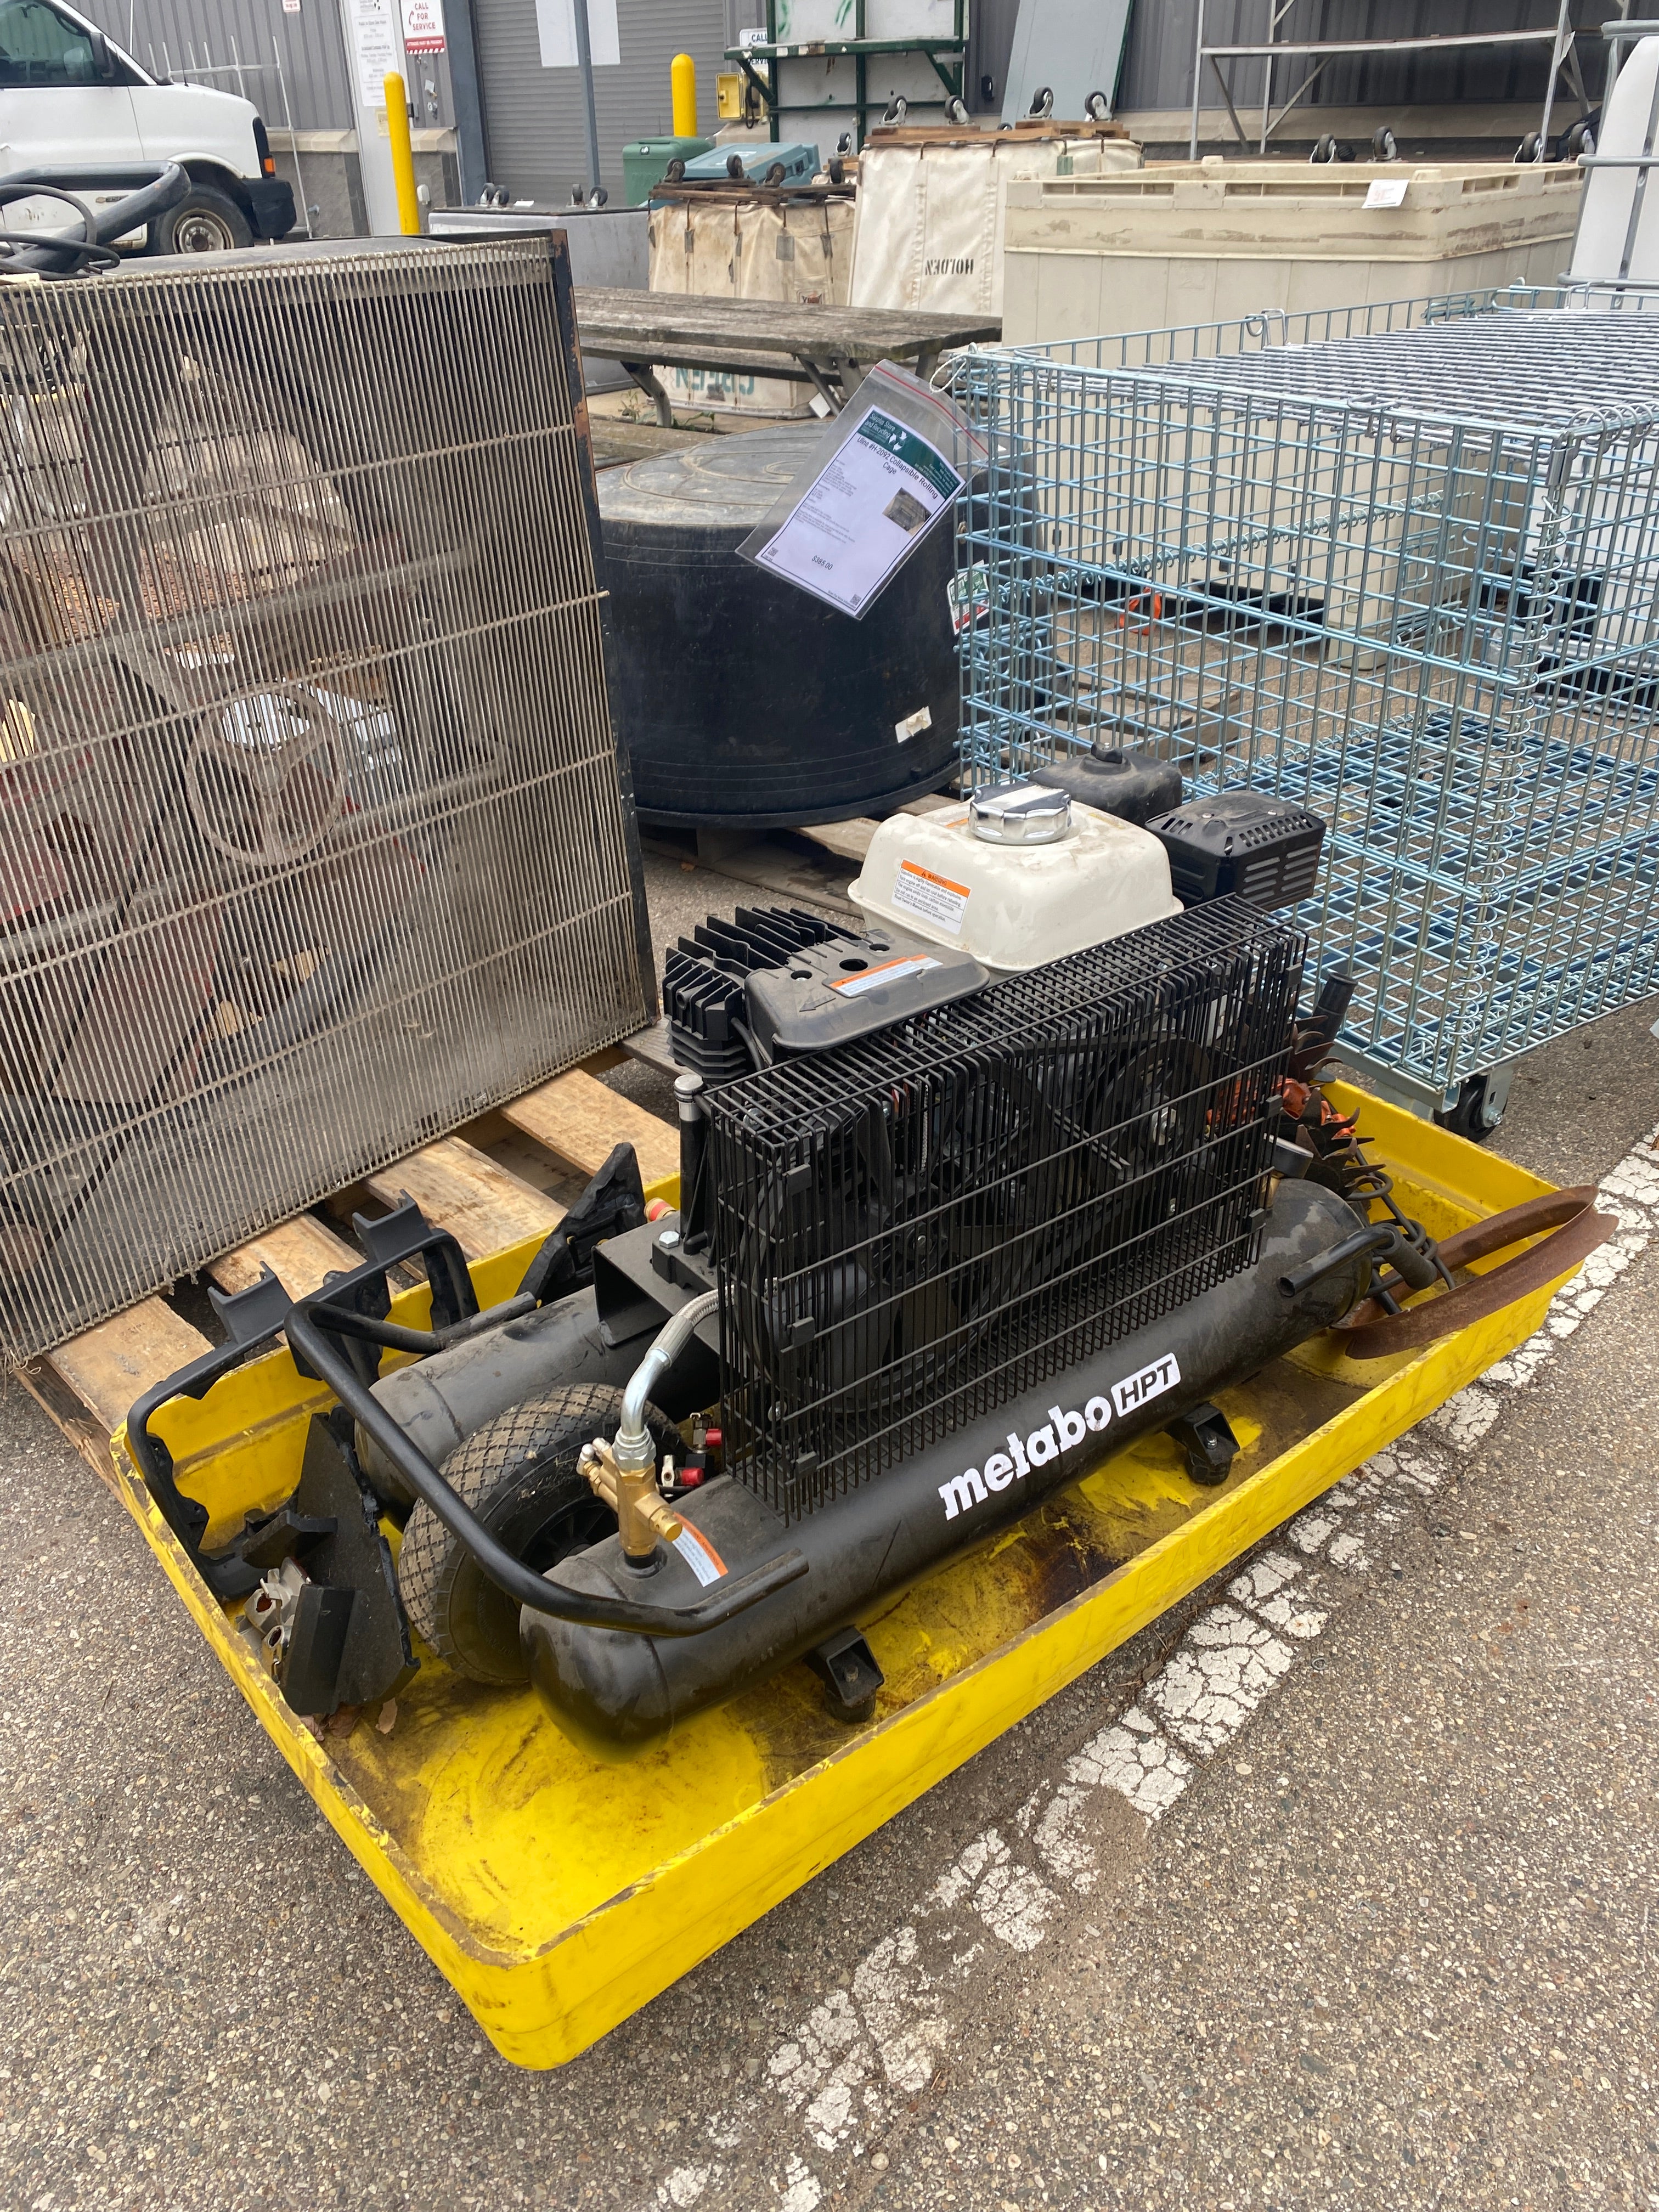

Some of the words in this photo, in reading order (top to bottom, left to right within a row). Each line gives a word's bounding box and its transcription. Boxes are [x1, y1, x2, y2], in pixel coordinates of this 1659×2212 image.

[413, 22, 436, 31] SERVICE
[752, 33, 768, 42] CALL
[926, 258, 974, 275] HOLDEN
[870, 413, 885, 426] Surplus
[885, 421, 895, 431] Store
[872, 424, 891, 439] Recycling
[857, 436, 870, 447] Uline
[869, 443, 891, 460] #H-2092
[890, 456, 919, 481] Collapsible
[918, 477, 938, 499] Rolling
[883, 462, 898, 474] Cage
[811, 555, 833, 571] $385.00
[927, 873, 947, 885] WARNING
[938, 1396, 1112, 1521] metabo
[1120, 1359, 1173, 1410] HPT
